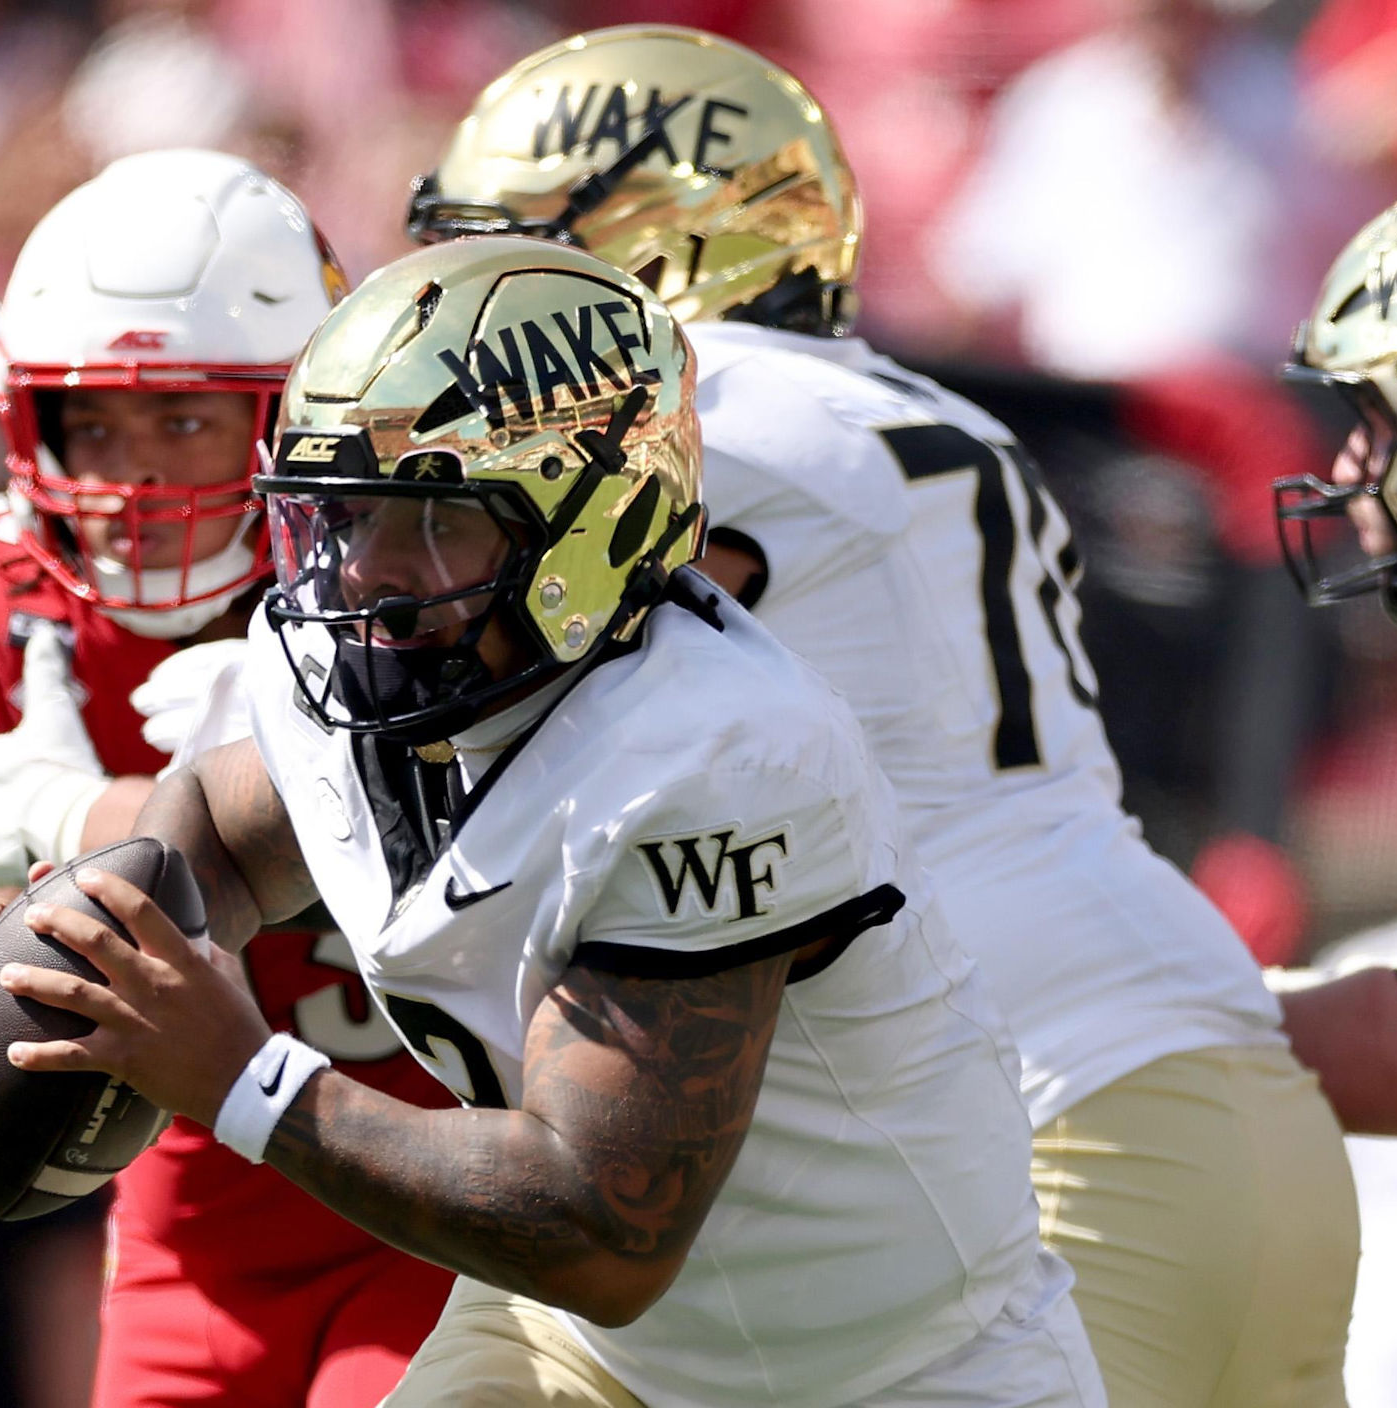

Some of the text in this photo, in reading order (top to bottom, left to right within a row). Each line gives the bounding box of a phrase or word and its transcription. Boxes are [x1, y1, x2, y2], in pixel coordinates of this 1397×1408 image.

[533, 84, 749, 180] WAKE
[437, 301, 661, 428] WAKE
[286, 437, 341, 462] ACC
[638, 830, 787, 922] WF
